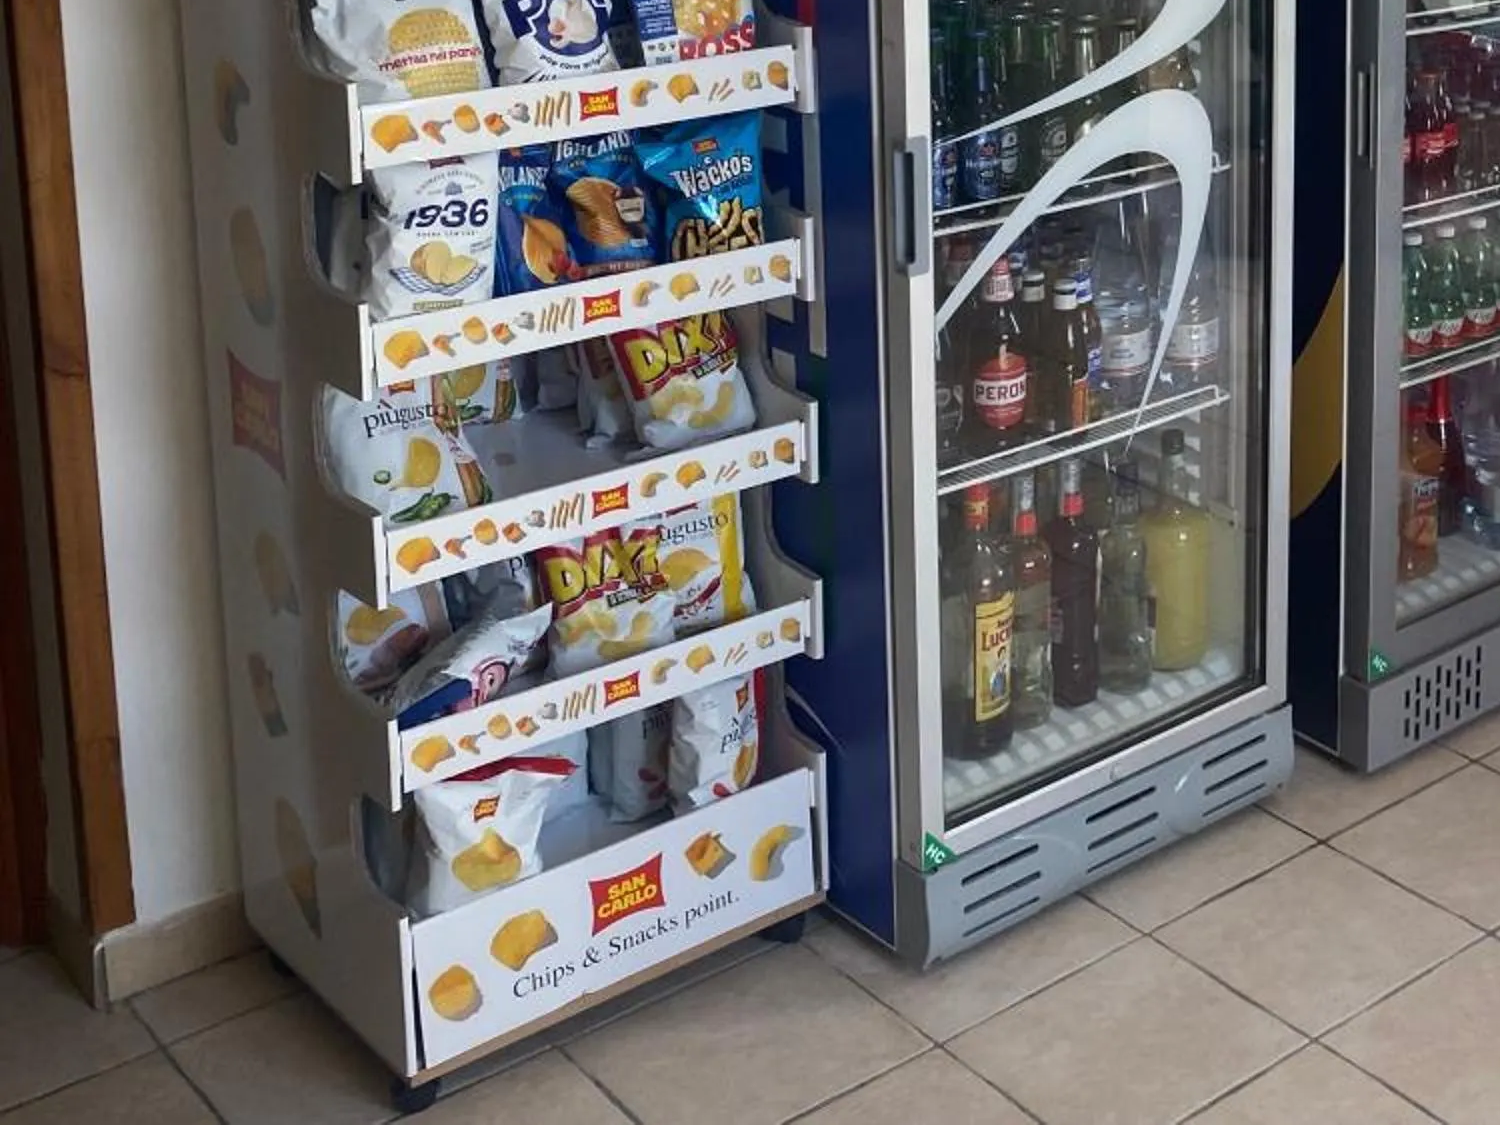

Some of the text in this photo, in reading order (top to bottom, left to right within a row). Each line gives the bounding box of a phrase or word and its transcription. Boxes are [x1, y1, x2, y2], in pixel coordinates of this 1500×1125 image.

[588, 94, 609, 104] SAN
[583, 102, 616, 114] CARLO
[404, 198, 489, 230] 1936
[591, 297, 612, 308] SAN
[586, 306, 617, 318] CARLO
[600, 490, 619, 502] SAN
[596, 497, 626, 512] CARLO
[607, 685, 637, 699] CARLO
[612, 680, 632, 692] SAN
[607, 873, 646, 900] SAN
[597, 884, 657, 918] CARLO
[512, 890, 740, 999] Chips & Snacks point.
